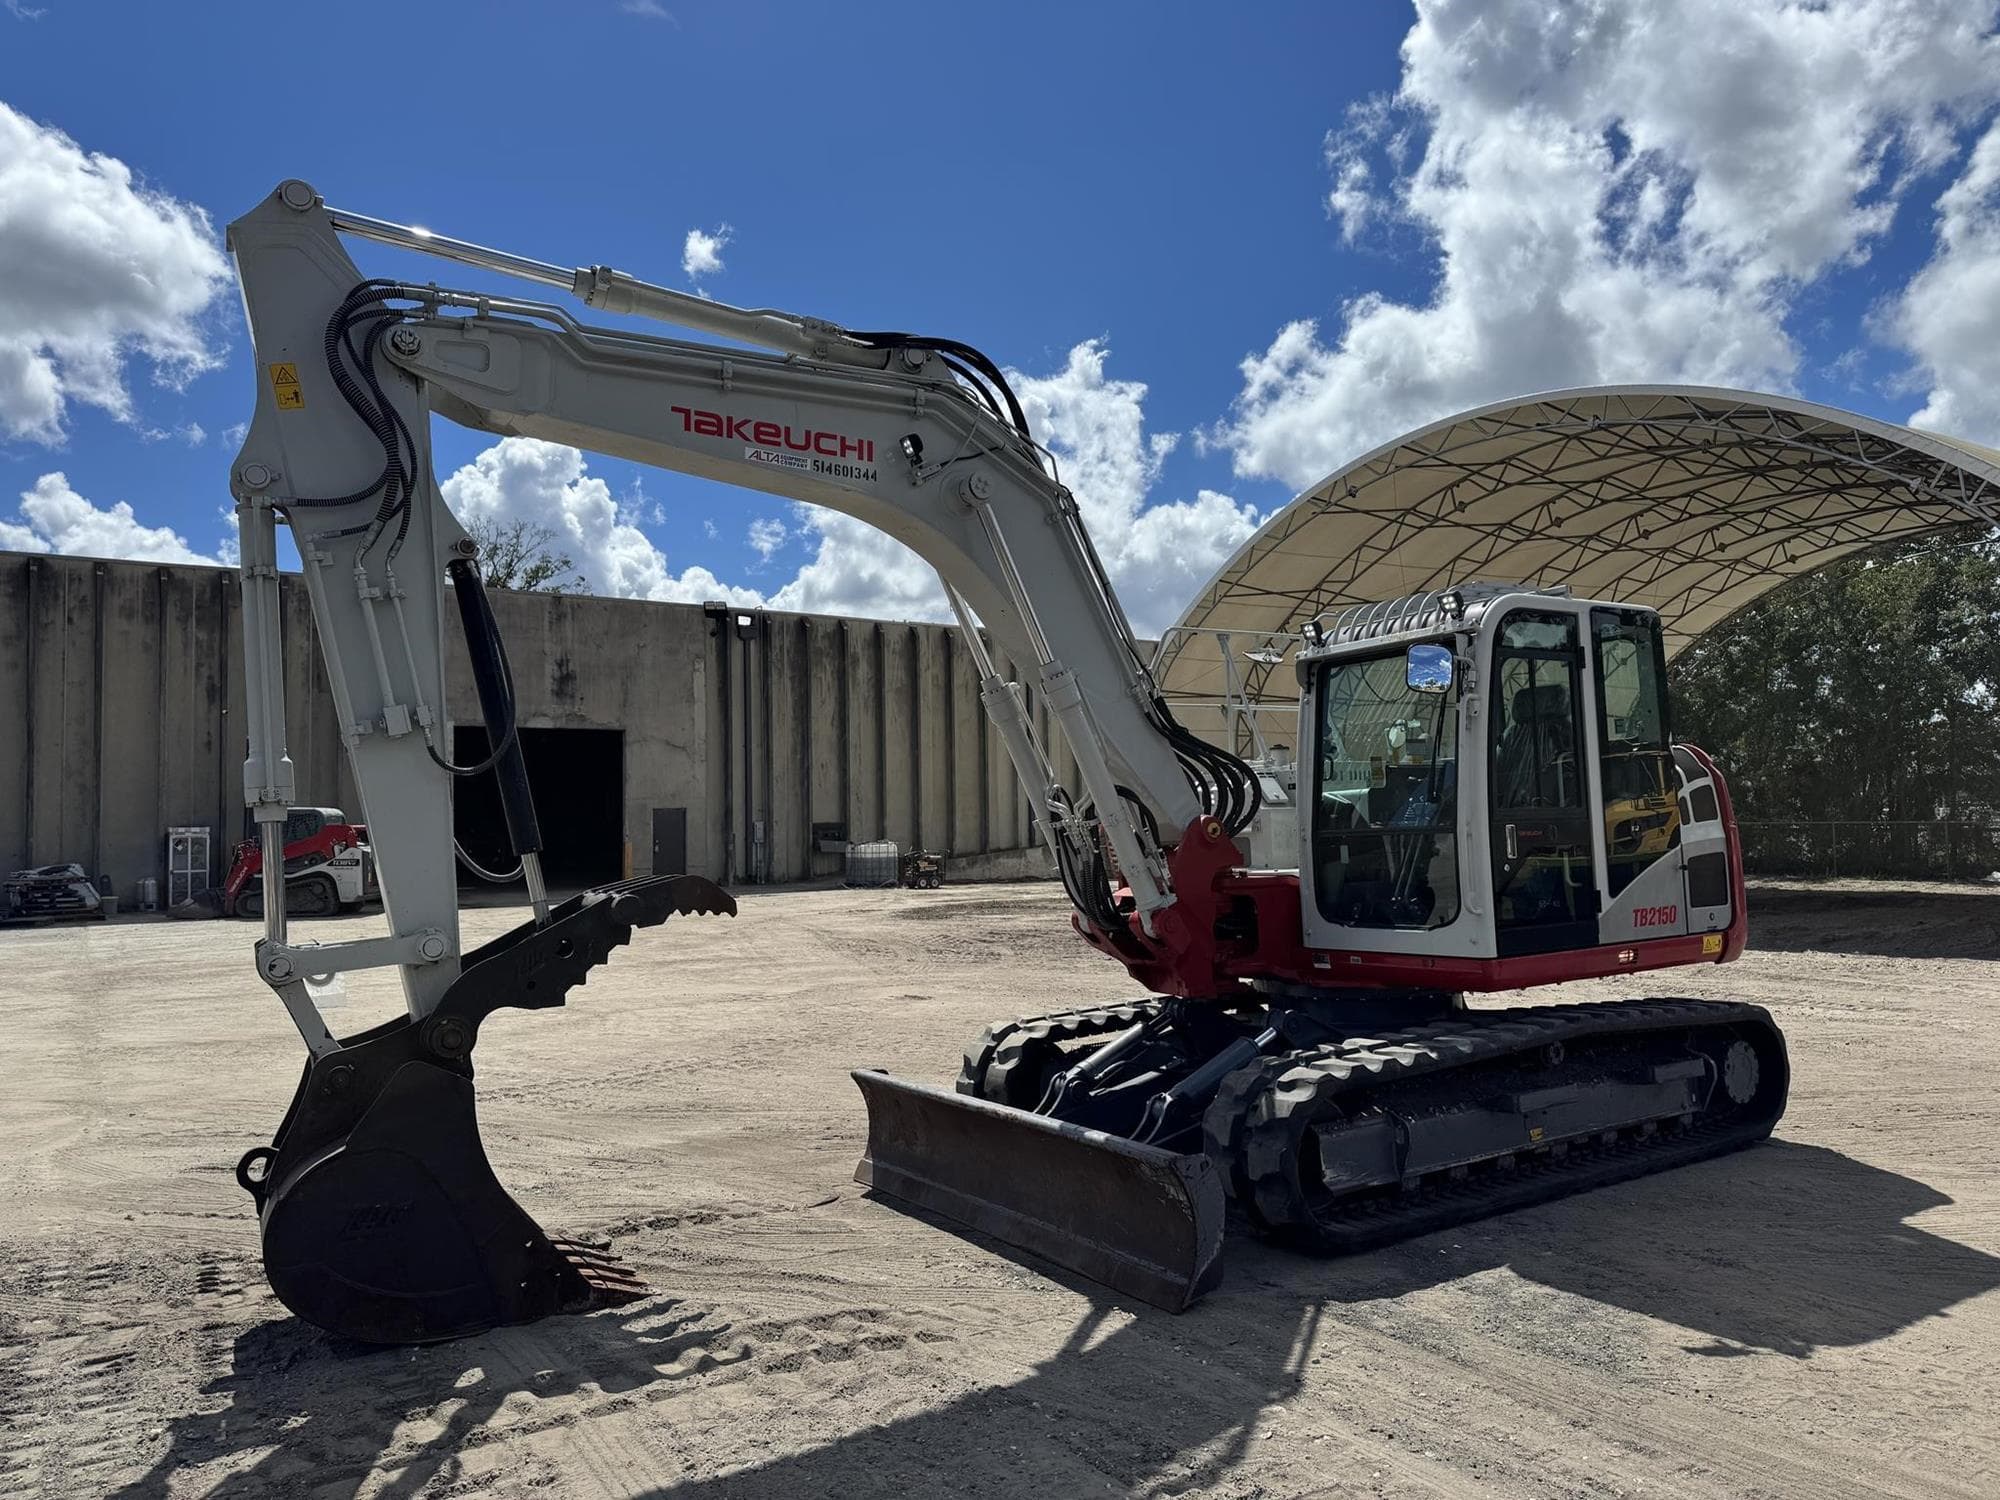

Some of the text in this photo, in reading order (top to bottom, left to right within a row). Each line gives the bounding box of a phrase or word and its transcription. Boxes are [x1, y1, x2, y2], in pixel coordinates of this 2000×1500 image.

[748, 449, 780, 464] ALTA
[780, 459, 808, 469] COMPANY
[813, 460, 877, 481] 514601344
[1633, 904, 1677, 927] TB2150
